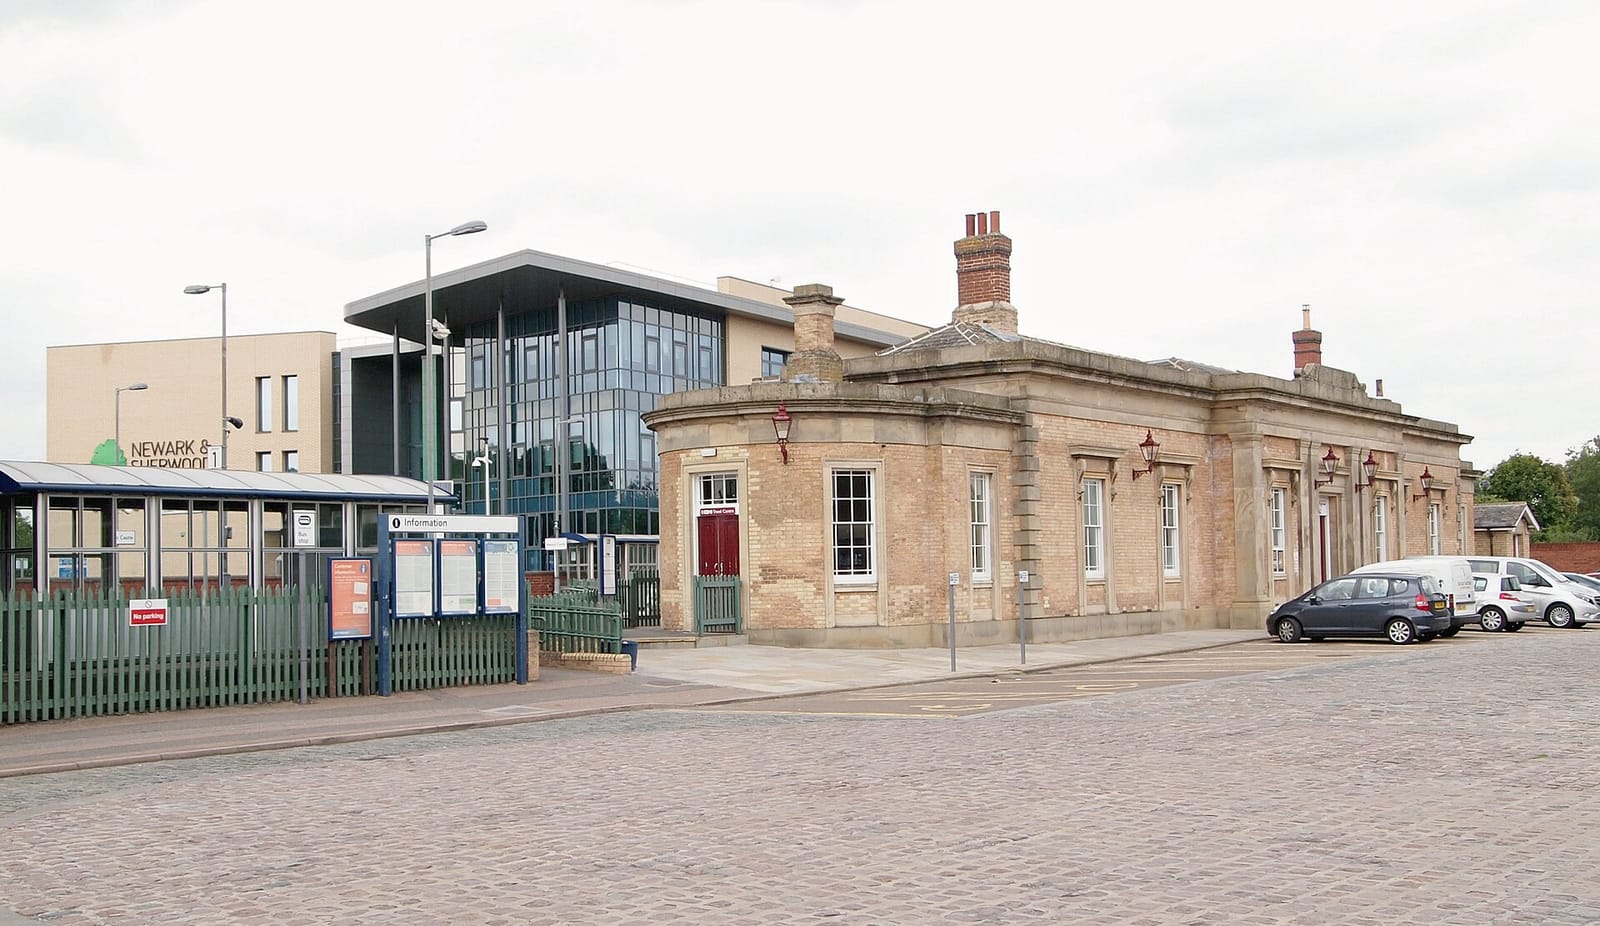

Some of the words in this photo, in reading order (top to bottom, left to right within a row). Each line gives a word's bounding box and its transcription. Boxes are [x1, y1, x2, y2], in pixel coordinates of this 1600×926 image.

[131, 440, 195, 457] NEWARK
[200, 439, 211, 455] &
[212, 451, 216, 467] 1
[404, 518, 448, 527] Information
[143, 612, 164, 621] parking
